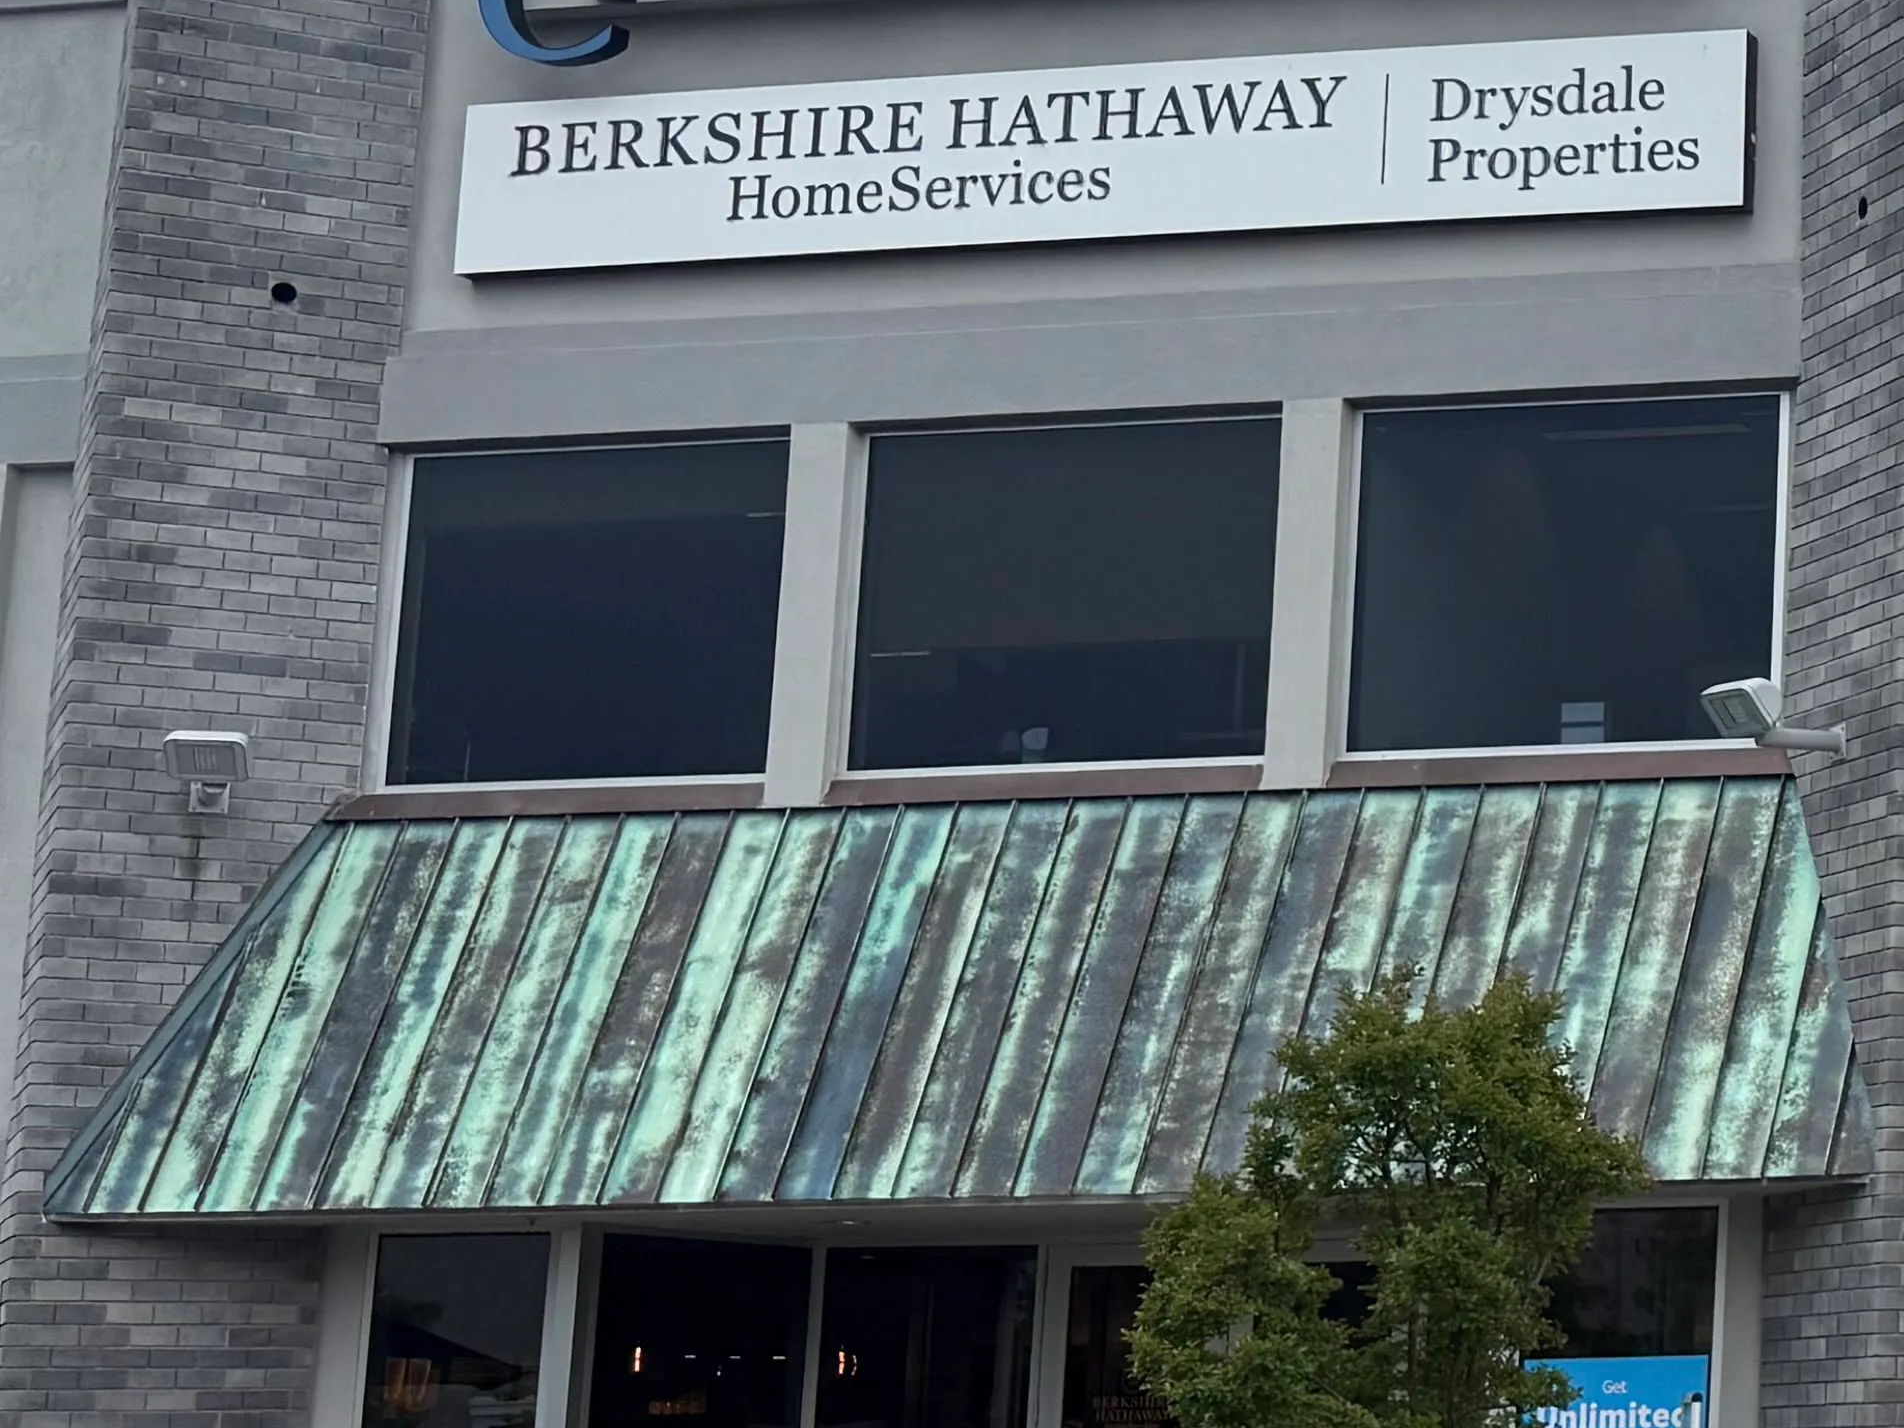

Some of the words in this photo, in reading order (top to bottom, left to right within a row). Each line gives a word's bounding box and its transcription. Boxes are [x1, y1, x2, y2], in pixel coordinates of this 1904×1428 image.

[509, 101, 925, 177] BERKSHIRE
[945, 76, 1347, 150] HATHAWAY
[1430, 65, 1666, 130] Drysdale
[1427, 125, 1701, 190] Properties
[726, 159, 1112, 222] HomeServices
[1602, 1379, 1629, 1395] Get
